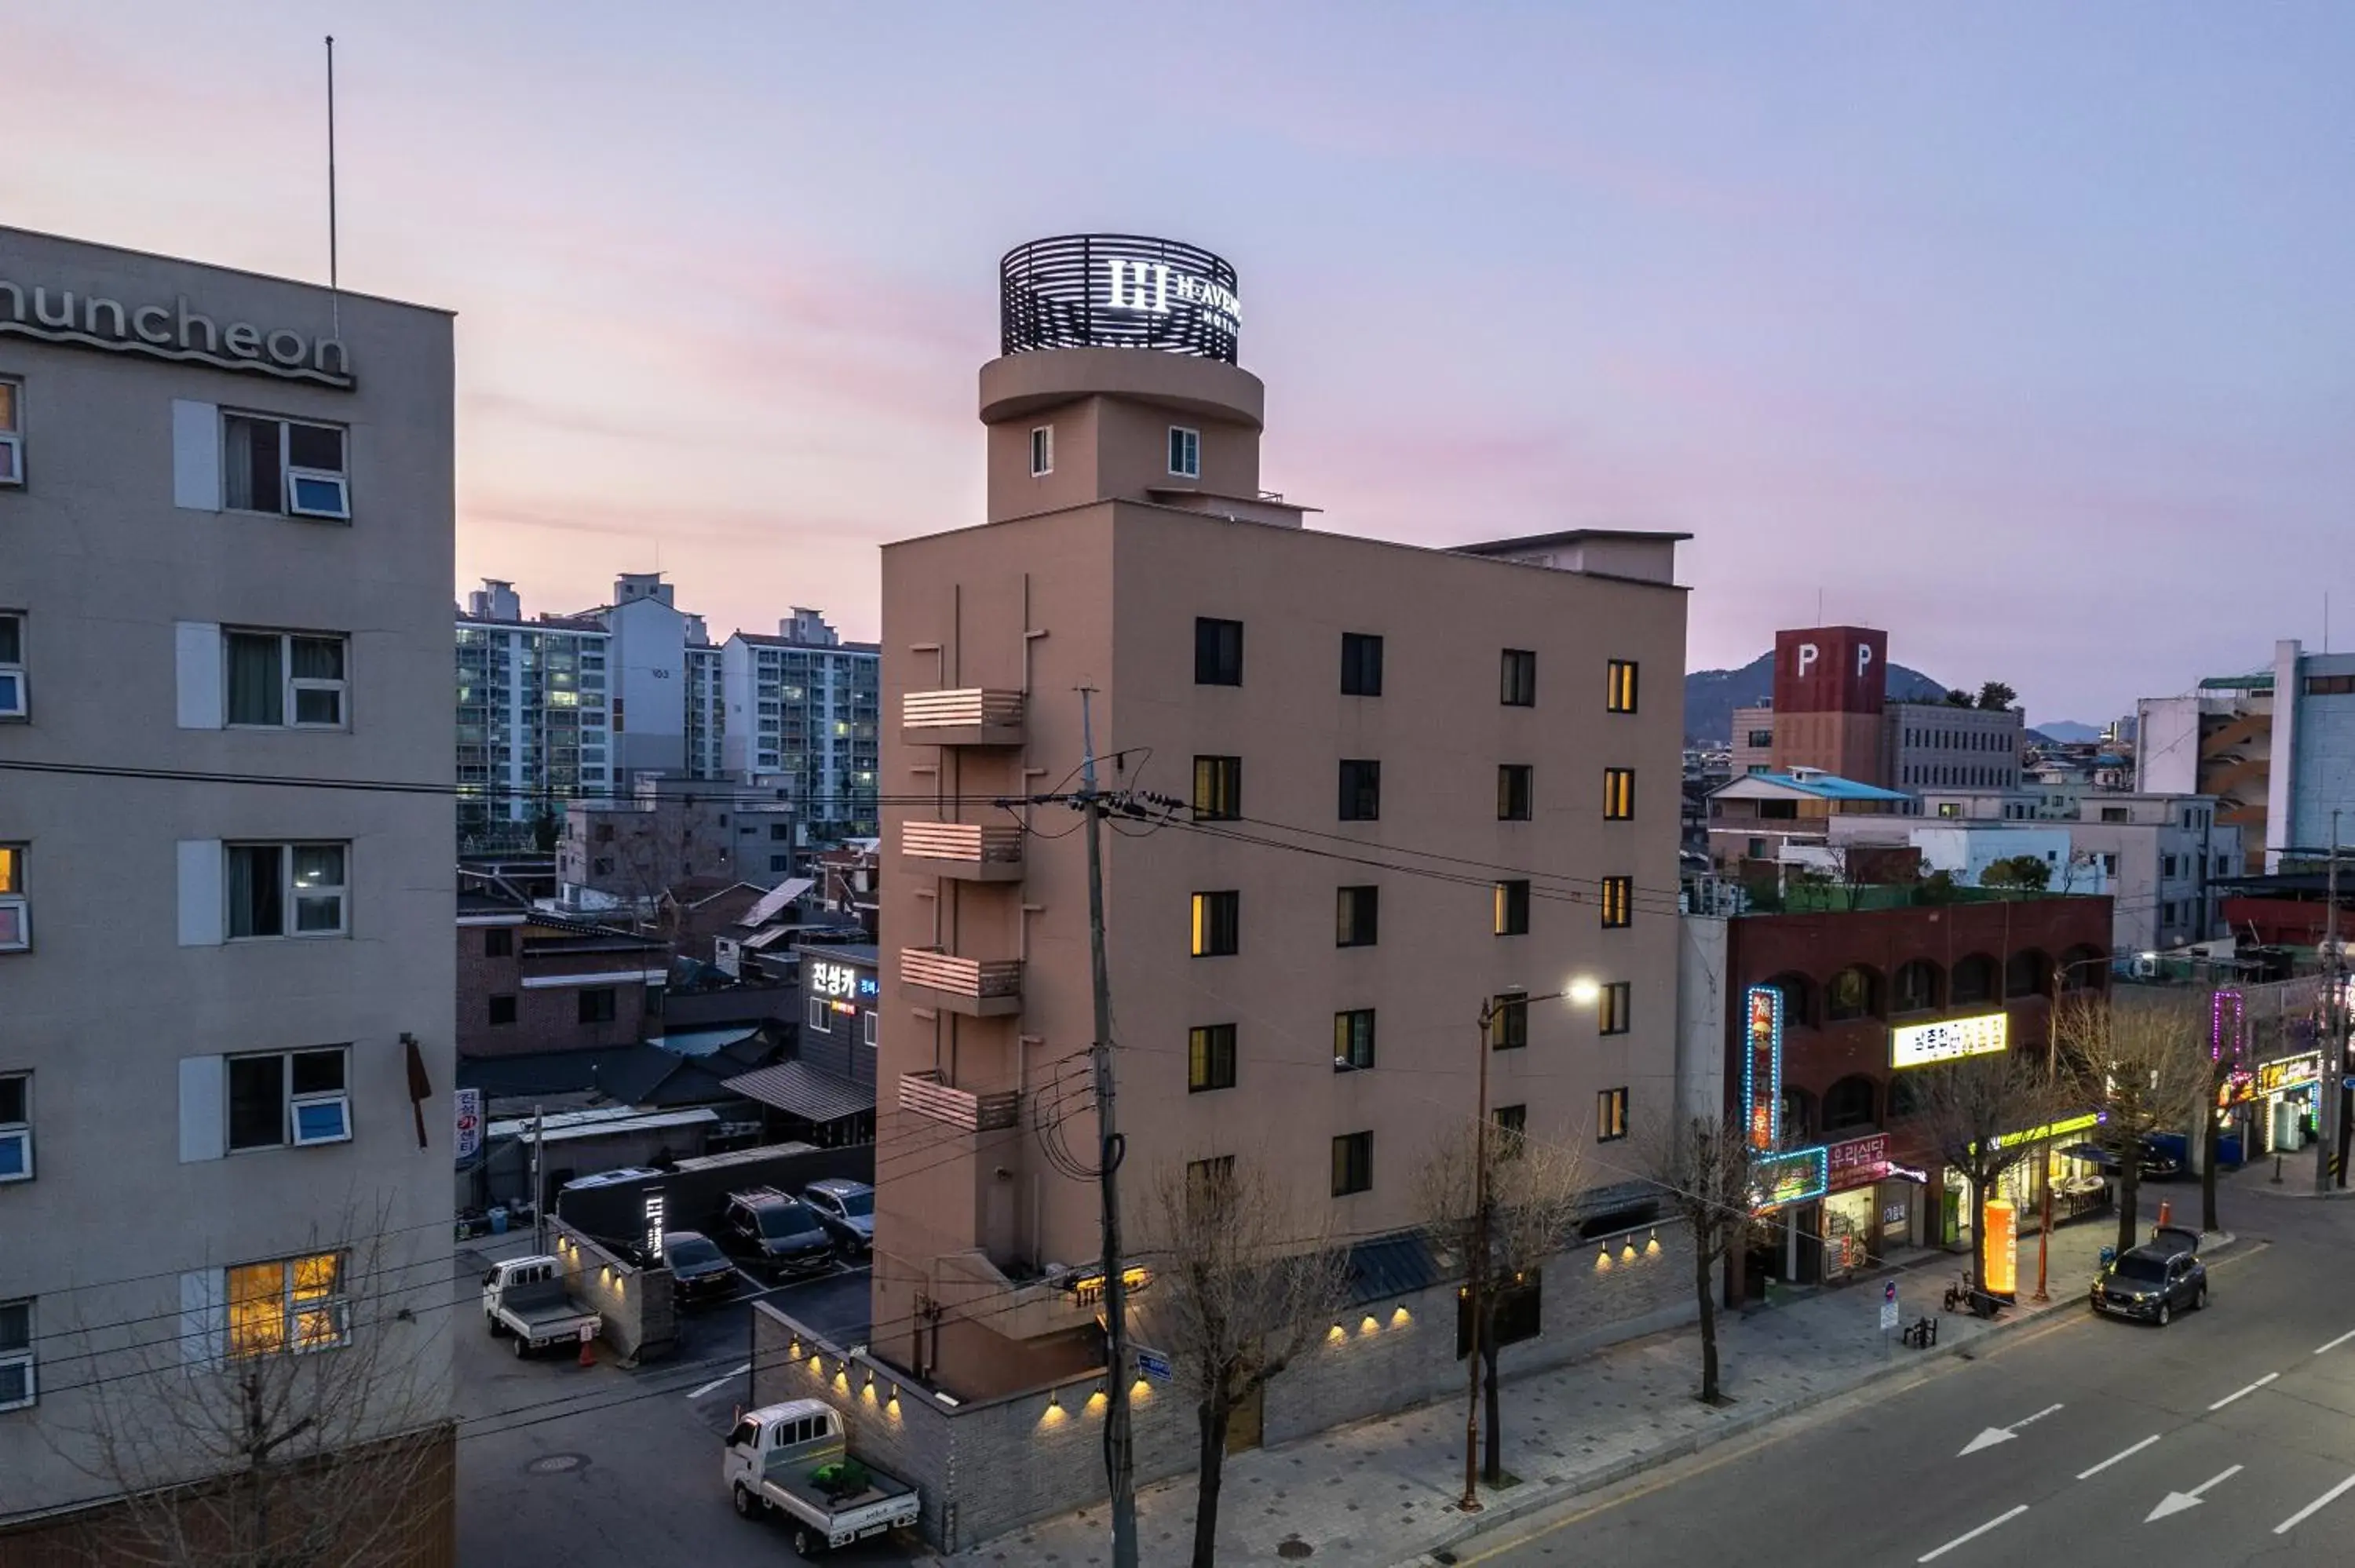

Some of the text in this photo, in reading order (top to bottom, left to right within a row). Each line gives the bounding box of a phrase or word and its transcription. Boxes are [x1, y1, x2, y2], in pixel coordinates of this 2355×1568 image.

[1798, 643, 1820, 677] P
[1857, 643, 1872, 677] P
[813, 963, 856, 998] 진성카
[1831, 1139, 1884, 1168] 우리식당
